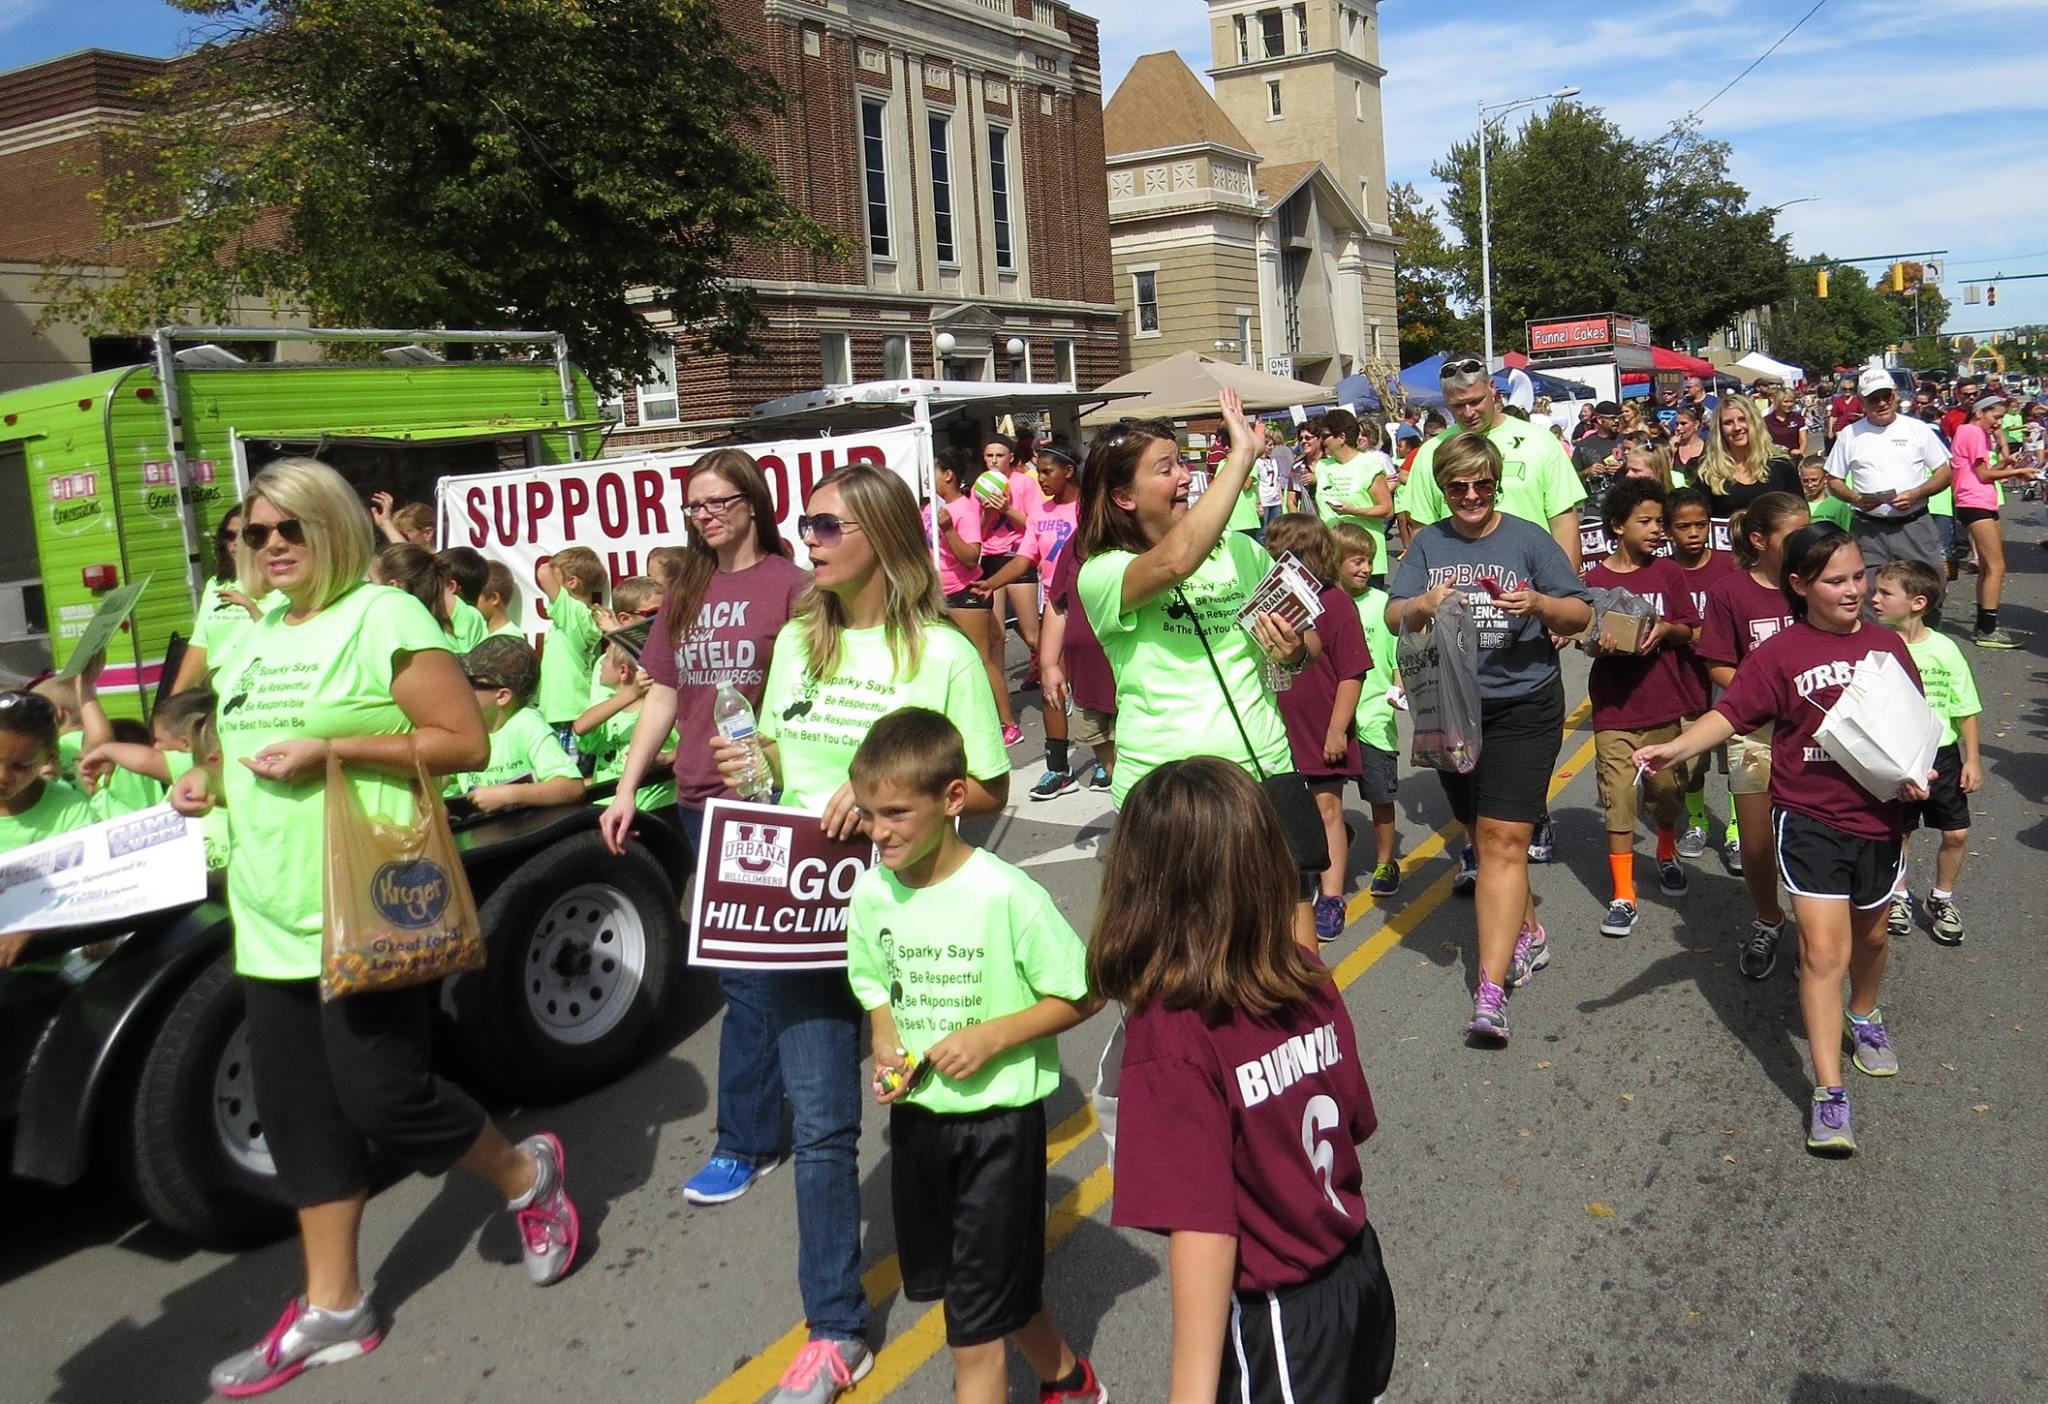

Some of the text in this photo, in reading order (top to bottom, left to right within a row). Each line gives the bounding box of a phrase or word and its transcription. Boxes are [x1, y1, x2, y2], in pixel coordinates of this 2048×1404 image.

[1535, 329, 1569, 344] Funnel
[1573, 325, 1605, 342] Cakes
[1271, 359, 1290, 368] ONE
[1271, 369, 1291, 377] WAY
[1194, 596, 1208, 606] Be
[697, 601, 750, 628] ACK
[1163, 622, 1175, 632] Be
[1176, 624, 1193, 635] The
[1194, 626, 1212, 636] Bst
[1213, 625, 1231, 634] You
[1476, 620, 1509, 629] AT A TIME
[260, 663, 318, 677] Sparky Says
[1931, 667, 1951, 677] Says
[269, 681, 311, 693] Respectful
[866, 680, 896, 695] Says
[245, 699, 305, 711] Be Responsible
[824, 695, 888, 713] Be Respectful
[225, 721, 237, 731] The
[240, 720, 256, 730] Best
[259, 720, 272, 729] You
[273, 717, 289, 728] Can
[292, 717, 305, 728] Be
[810, 712, 872, 729] Be Responsib
[784, 728, 798, 739] The
[801, 730, 821, 741] Best
[823, 733, 840, 744] You
[842, 735, 860, 747] Can
[127, 823, 185, 850] WEEK
[725, 841, 786, 866] URBANA
[82, 863, 135, 883] Sponsored
[724, 871, 784, 886] HILLCLIMBERS
[789, 857, 866, 901] GO
[704, 901, 849, 933] HILLCLIM
[898, 944, 985, 961] Sparky Says
[910, 970, 982, 986] Be Respectful
[905, 995, 917, 1007] Be
[905, 1018, 925, 1030] Best
[939, 1018, 962, 1031] Can
